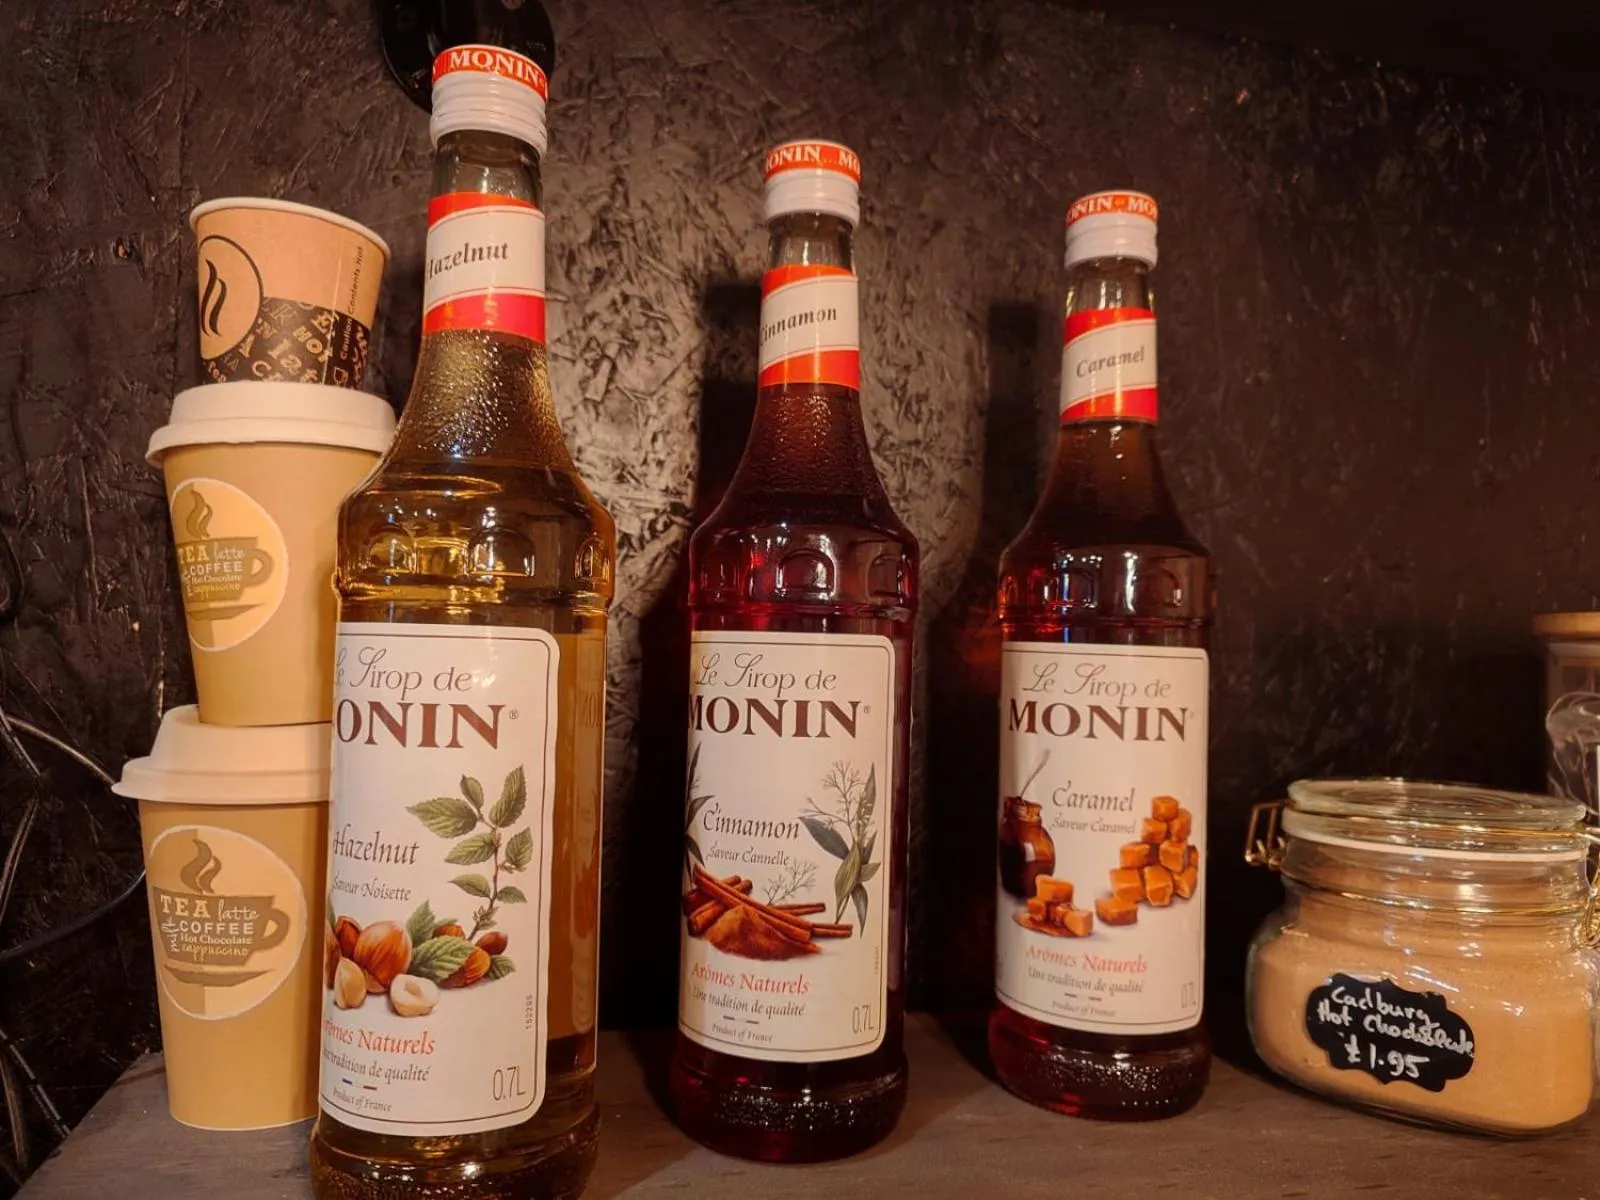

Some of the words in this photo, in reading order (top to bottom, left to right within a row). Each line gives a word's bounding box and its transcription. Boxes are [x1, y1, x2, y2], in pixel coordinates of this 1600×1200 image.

[449, 50, 540, 86] MONIN
[1076, 346, 1145, 378] Caramel
[190, 560, 245, 577] COFFEE
[349, 645, 422, 700] Sirop
[434, 666, 472, 693] de
[695, 652, 721, 686] Le
[724, 652, 796, 698] Sirop
[805, 669, 837, 691] de
[1022, 662, 1056, 693] Le
[1063, 662, 1137, 706] Sirop
[1144, 679, 1172, 699] de
[1052, 780, 1136, 813] Caramel
[703, 802, 800, 840] Cinnamon
[1050, 811, 1087, 832] Saveur
[1090, 817, 1136, 835] Caramel
[333, 823, 420, 865] Hazelnut
[706, 841, 740, 863] Saveur
[741, 845, 791, 867] Cannelle
[360, 876, 412, 901] Noisette
[160, 894, 211, 919] TEA
[217, 898, 260, 922] latte
[179, 919, 255, 935] COFFEE
[180, 933, 198, 944] Hot
[199, 934, 253, 945] Chocolate
[1026, 944, 1077, 967] Arômes
[1083, 952, 1148, 973] Naturels
[690, 961, 736, 986] Arômes
[739, 971, 810, 995] Naturels
[1028, 966, 1046, 980] Une
[1047, 971, 1091, 990] tradition
[1094, 976, 1107, 993] de
[1109, 979, 1145, 997] qualité
[708, 991, 748, 1011] tradition
[750, 999, 764, 1014] de
[765, 1002, 805, 1020] qualité
[852, 1003, 875, 1035] 0.7L
[1317, 998, 1353, 1027] Hot
[358, 1027, 436, 1056] Naturels
[711, 1024, 738, 1038] Product
[747, 1030, 773, 1042] France
[1344, 1034, 1430, 1079] £1.95
[368, 1059, 383, 1079] de
[384, 1065, 430, 1085] qualité
[492, 1066, 527, 1101] 0.7L
